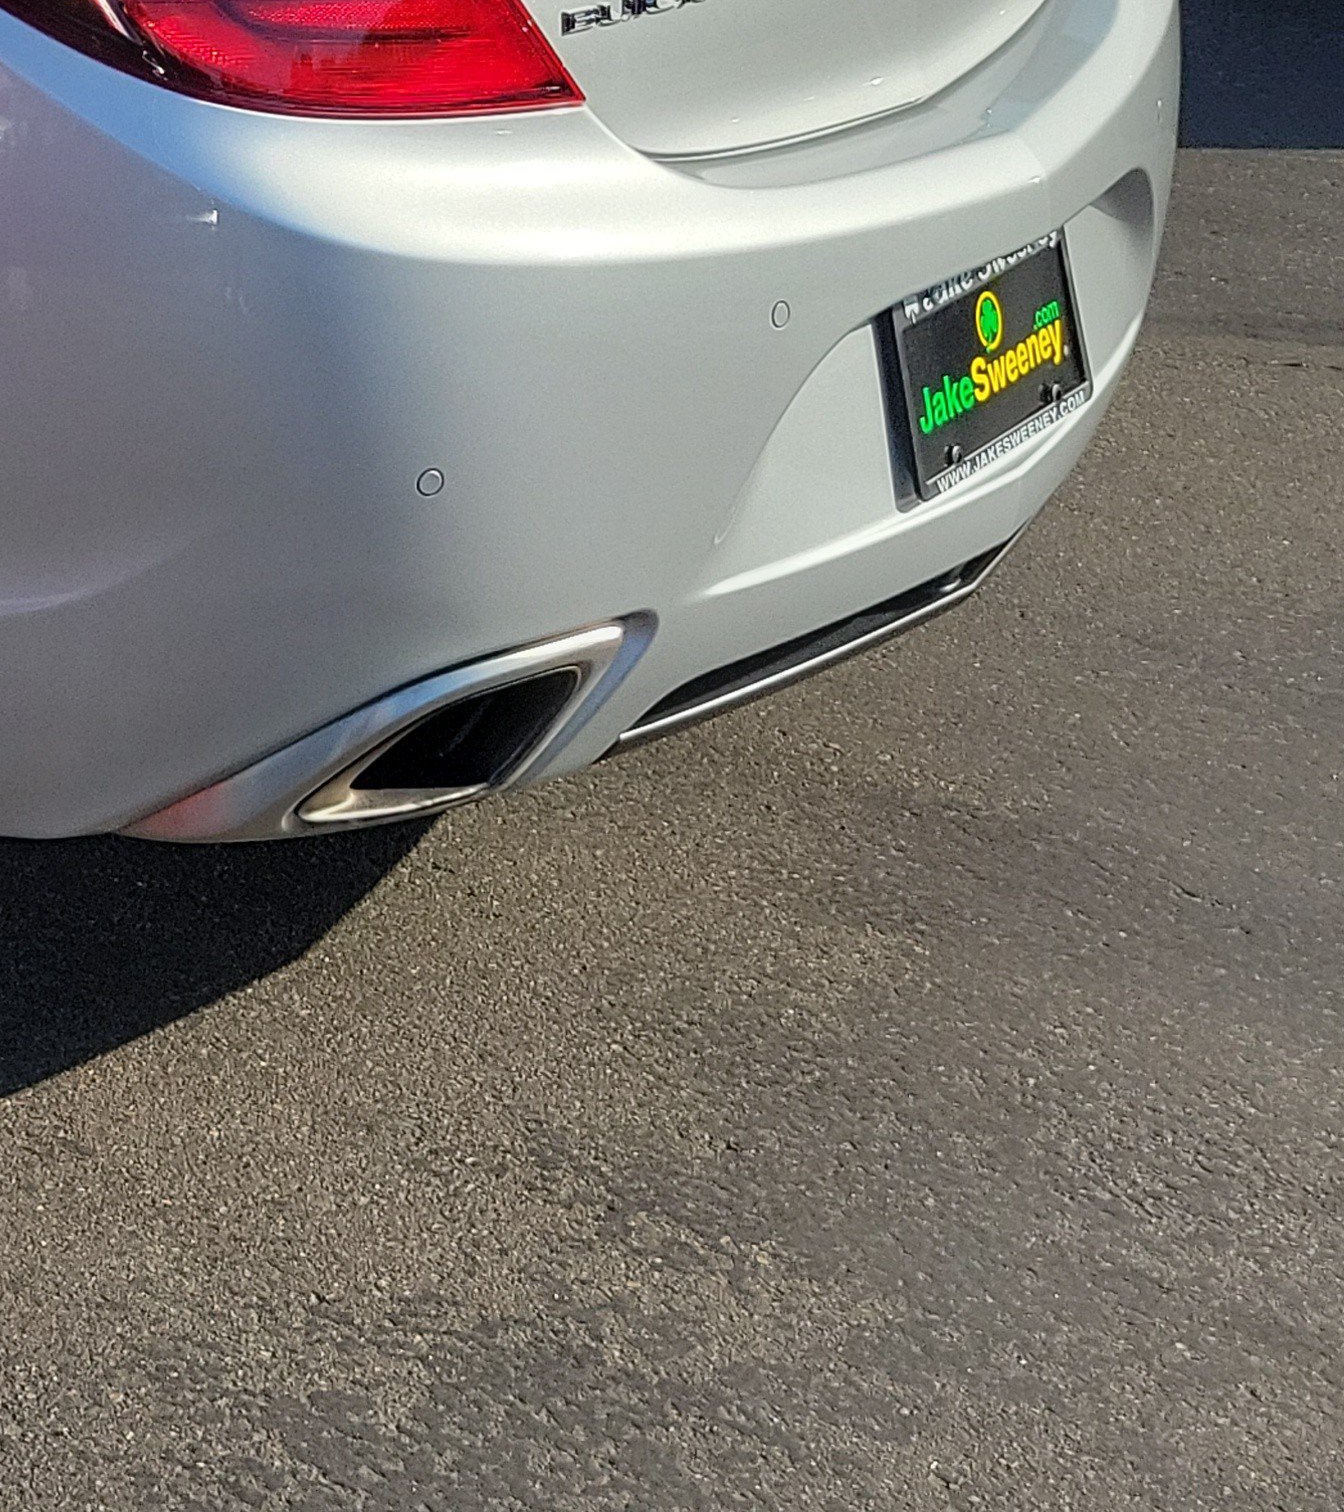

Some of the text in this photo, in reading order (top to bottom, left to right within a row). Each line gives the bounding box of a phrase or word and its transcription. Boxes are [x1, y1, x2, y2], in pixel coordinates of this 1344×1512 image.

[1033, 300, 1060, 331] .com
[919, 318, 1062, 435] JakeSweeney
[935, 390, 1086, 494] WWW.JAKESWEENEY.COM
